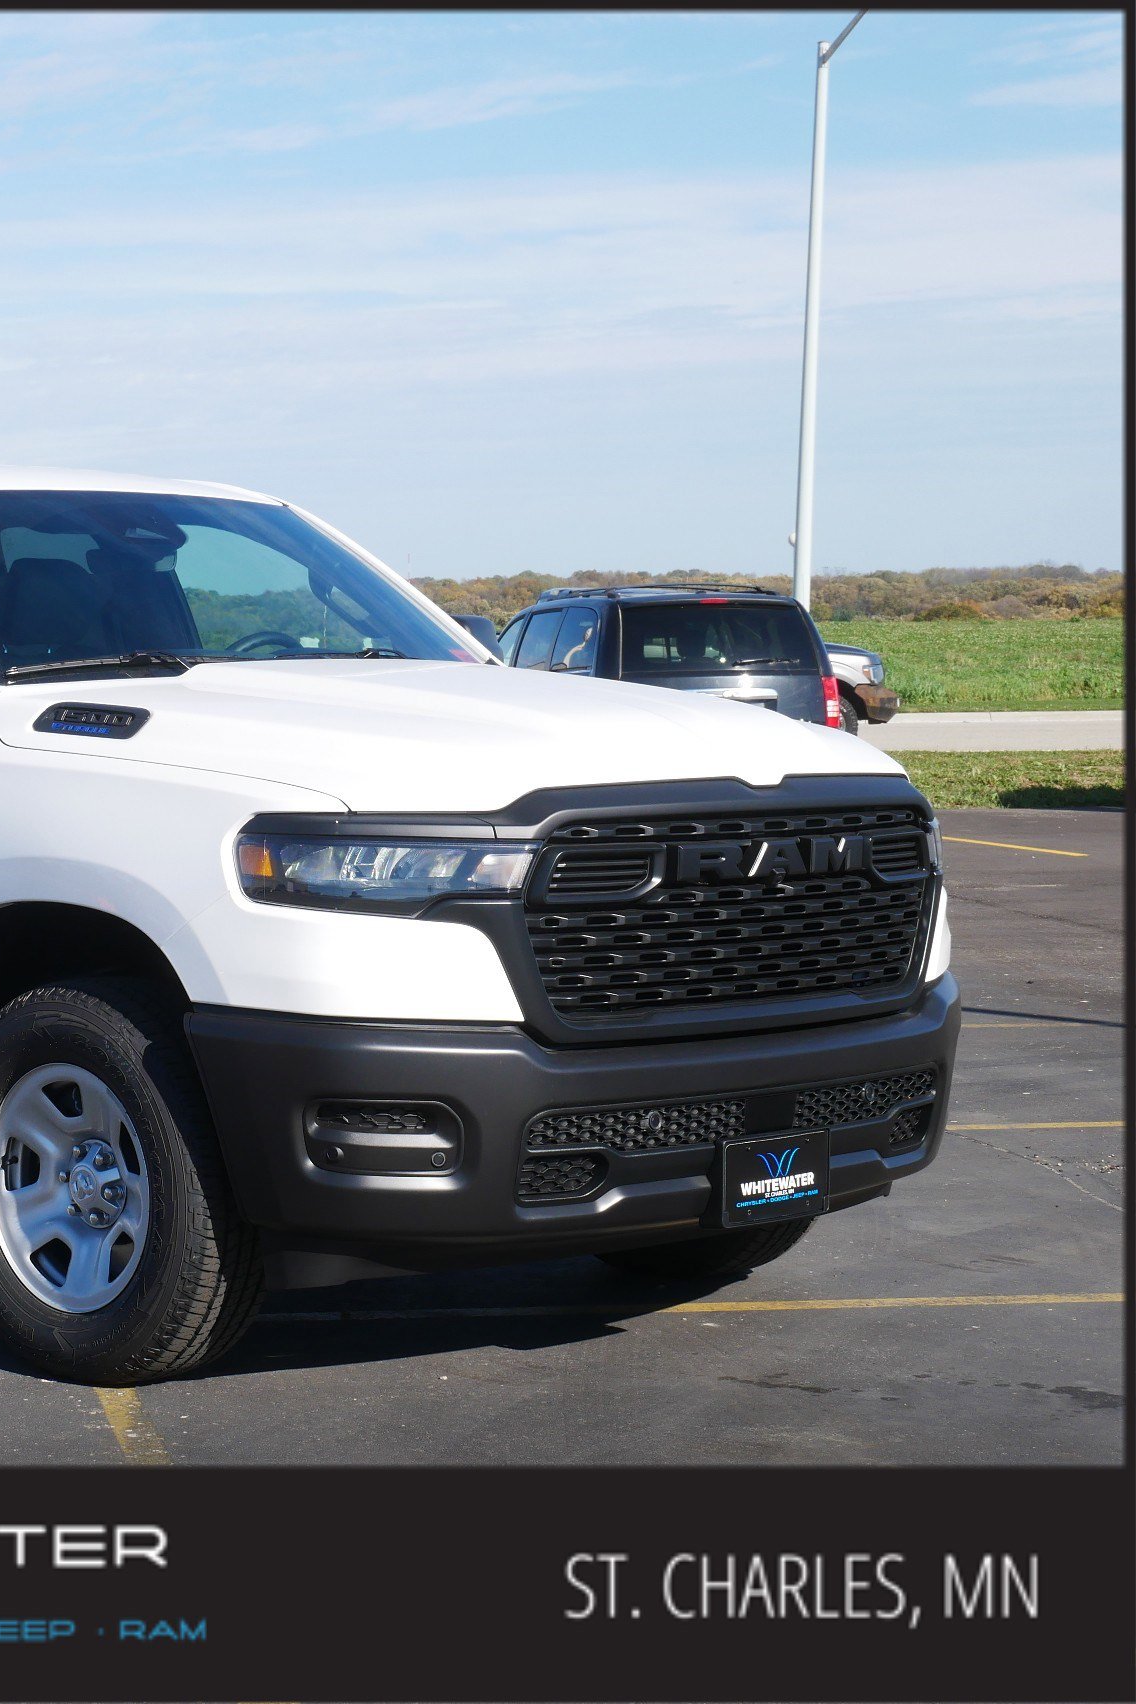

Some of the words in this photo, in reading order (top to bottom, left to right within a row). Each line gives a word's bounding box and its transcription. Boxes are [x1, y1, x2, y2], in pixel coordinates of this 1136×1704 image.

[677, 836, 864, 882] RAM
[740, 1171, 815, 1196] WHITEWATER
[736, 1199, 767, 1208] CHRYSLER
[770, 1195, 790, 1203] DODGE
